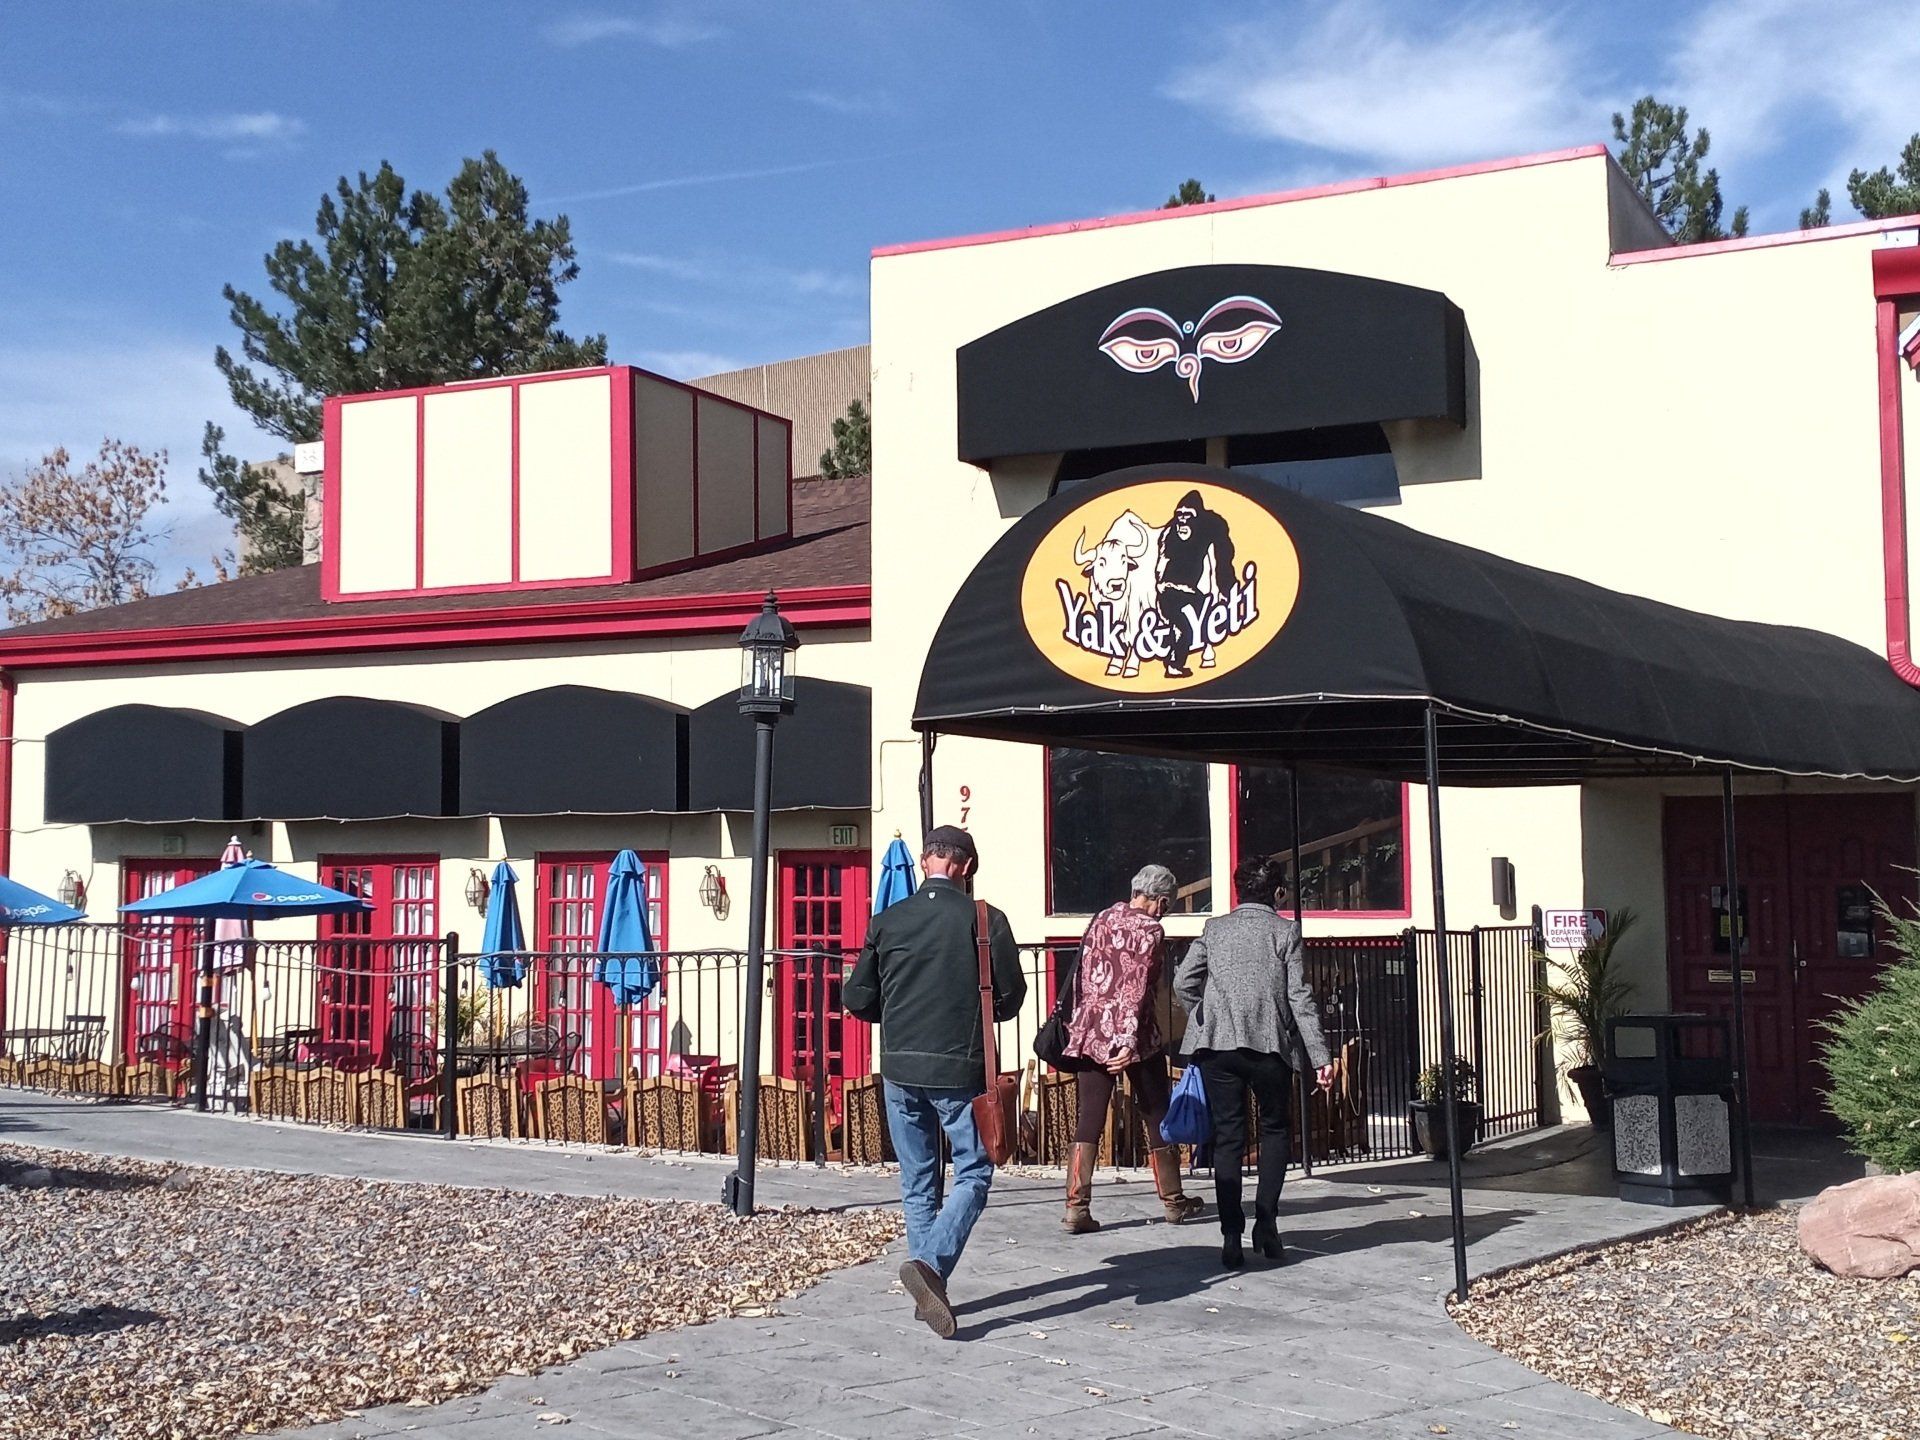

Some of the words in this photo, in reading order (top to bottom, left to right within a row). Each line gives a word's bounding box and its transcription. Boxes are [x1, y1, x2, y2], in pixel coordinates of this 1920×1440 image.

[1056, 578, 1126, 659] Yak
[1135, 608, 1173, 661] &
[1181, 561, 1257, 653] Yeti
[833, 827, 853, 845] EXIT
[276, 893, 323, 902] pepsi
[13, 904, 53, 918] pepsi
[1553, 915, 1588, 927] FIRE
